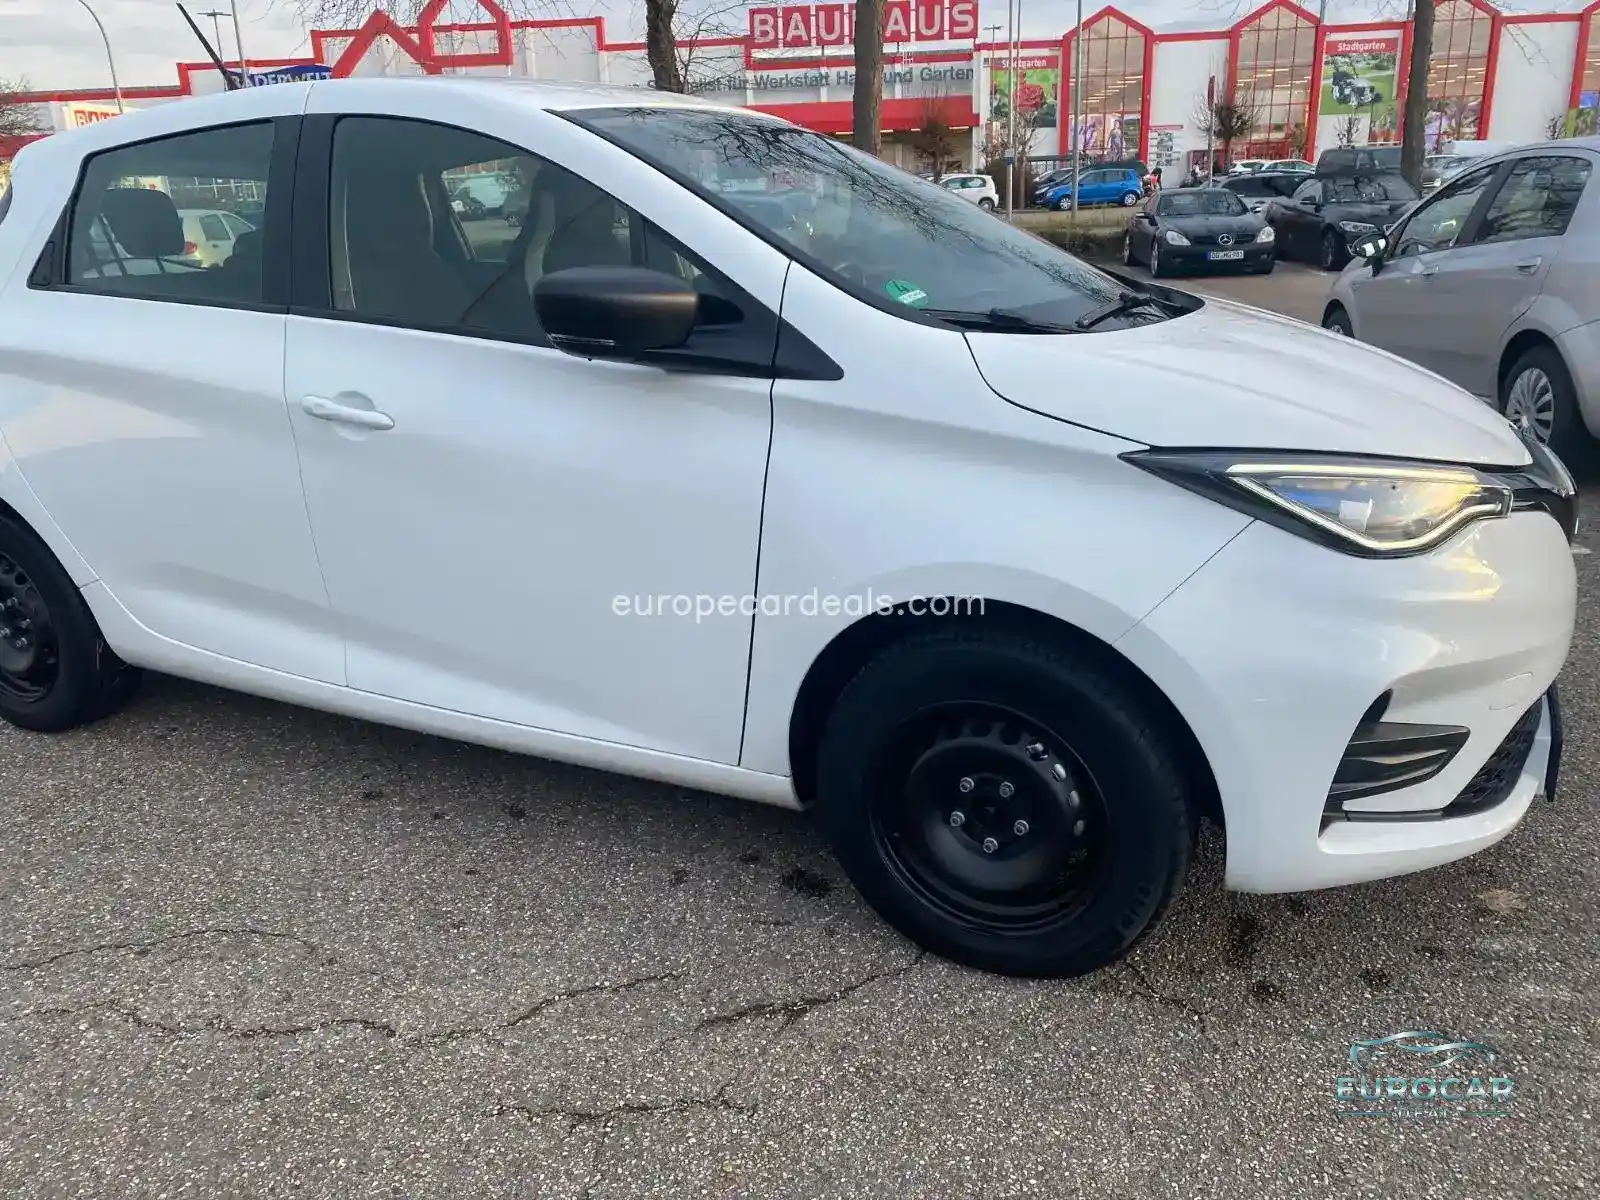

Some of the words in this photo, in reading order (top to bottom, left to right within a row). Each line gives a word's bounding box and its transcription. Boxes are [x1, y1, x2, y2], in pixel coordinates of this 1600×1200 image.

[753, 3, 975, 43] BAUAUS
[1337, 42, 1386, 53] Stadtgarten
[755, 72, 831, 89] Werkstatt
[884, 67, 914, 84] und
[920, 65, 974, 82] Garten
